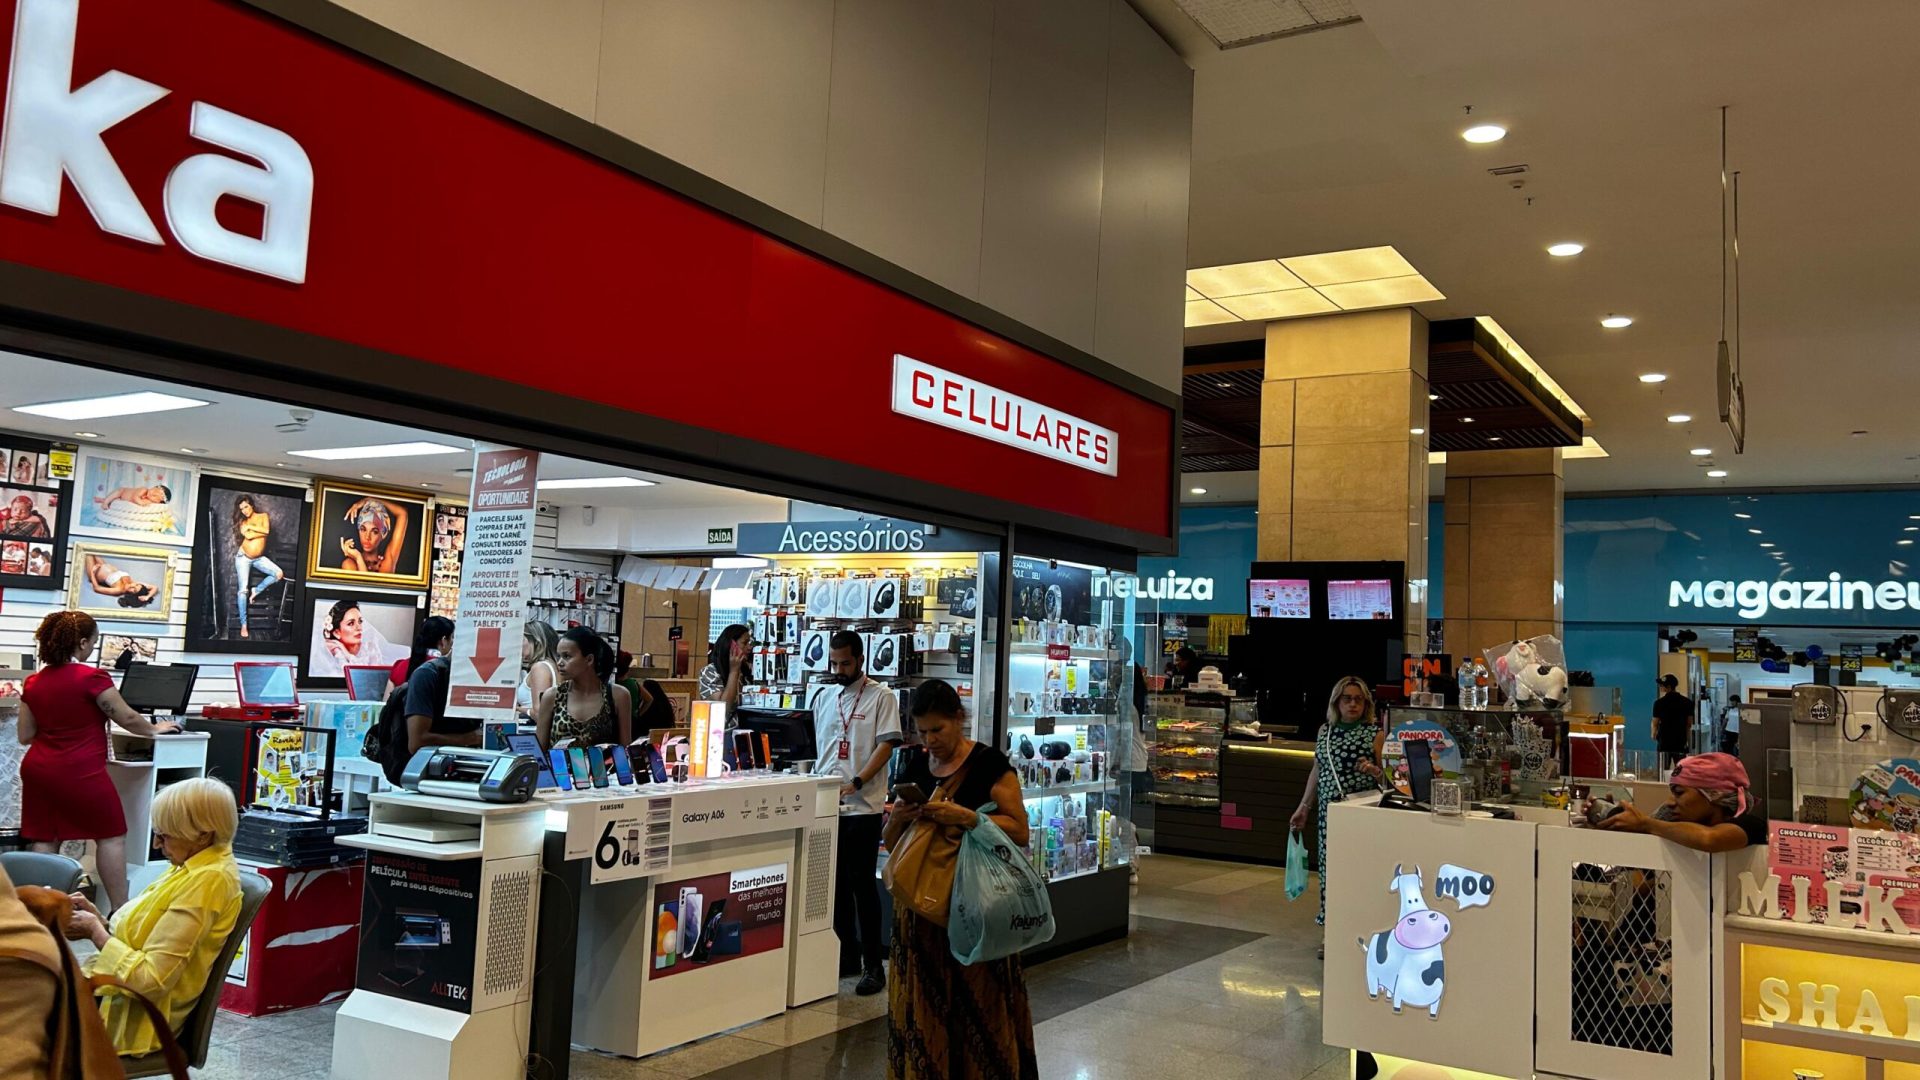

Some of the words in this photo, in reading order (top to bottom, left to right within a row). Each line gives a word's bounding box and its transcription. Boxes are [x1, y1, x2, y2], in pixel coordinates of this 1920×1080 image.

[911, 370, 1109, 465] CELULARES
[478, 491, 529, 506] OPORTUNIDADE
[480, 515, 505, 523] PARCELE
[475, 524, 503, 532] COMPRAS
[514, 522, 526, 530] ATÉ
[709, 530, 733, 543] SAÍDA
[778, 522, 926, 552] Acessórios
[471, 541, 501, 549] CONSULTE
[473, 549, 513, 557] VENDEDORES
[480, 557, 514, 565] CONDIÇÕES
[472, 570, 510, 579] APROVEITE
[470, 580, 507, 589] PELÍCULAS
[508, 580, 518, 588] DE
[466, 590, 500, 598] HIDROGEL
[501, 590, 520, 598] PARA
[463, 610, 513, 618] SMARTPHONES
[515, 610, 520, 618] E
[1398, 730, 1444, 741] PANDORA
[599, 803, 624, 811] SAMSUNG
[682, 813, 710, 823] Galaxy
[711, 809, 725, 820] A06
[1779, 828, 1837, 840] CHOCOLATUDOS
[595, 820, 620, 870] 6
[371, 865, 408, 879] PELÍCULA
[731, 872, 784, 891] Smartphones
[1881, 879, 1919, 889] PREMIUM
[390, 879, 408, 887] para
[409, 882, 427, 891] seus
[428, 885, 474, 899] dispositivos
[738, 891, 751, 902] das
[752, 886, 784, 899] melhores
[747, 899, 772, 912] marcas
[773, 897, 783, 906] do
[1737, 871, 1911, 935] MILK
[756, 909, 780, 921] mundo
[431, 981, 467, 1000] ALLTEK
